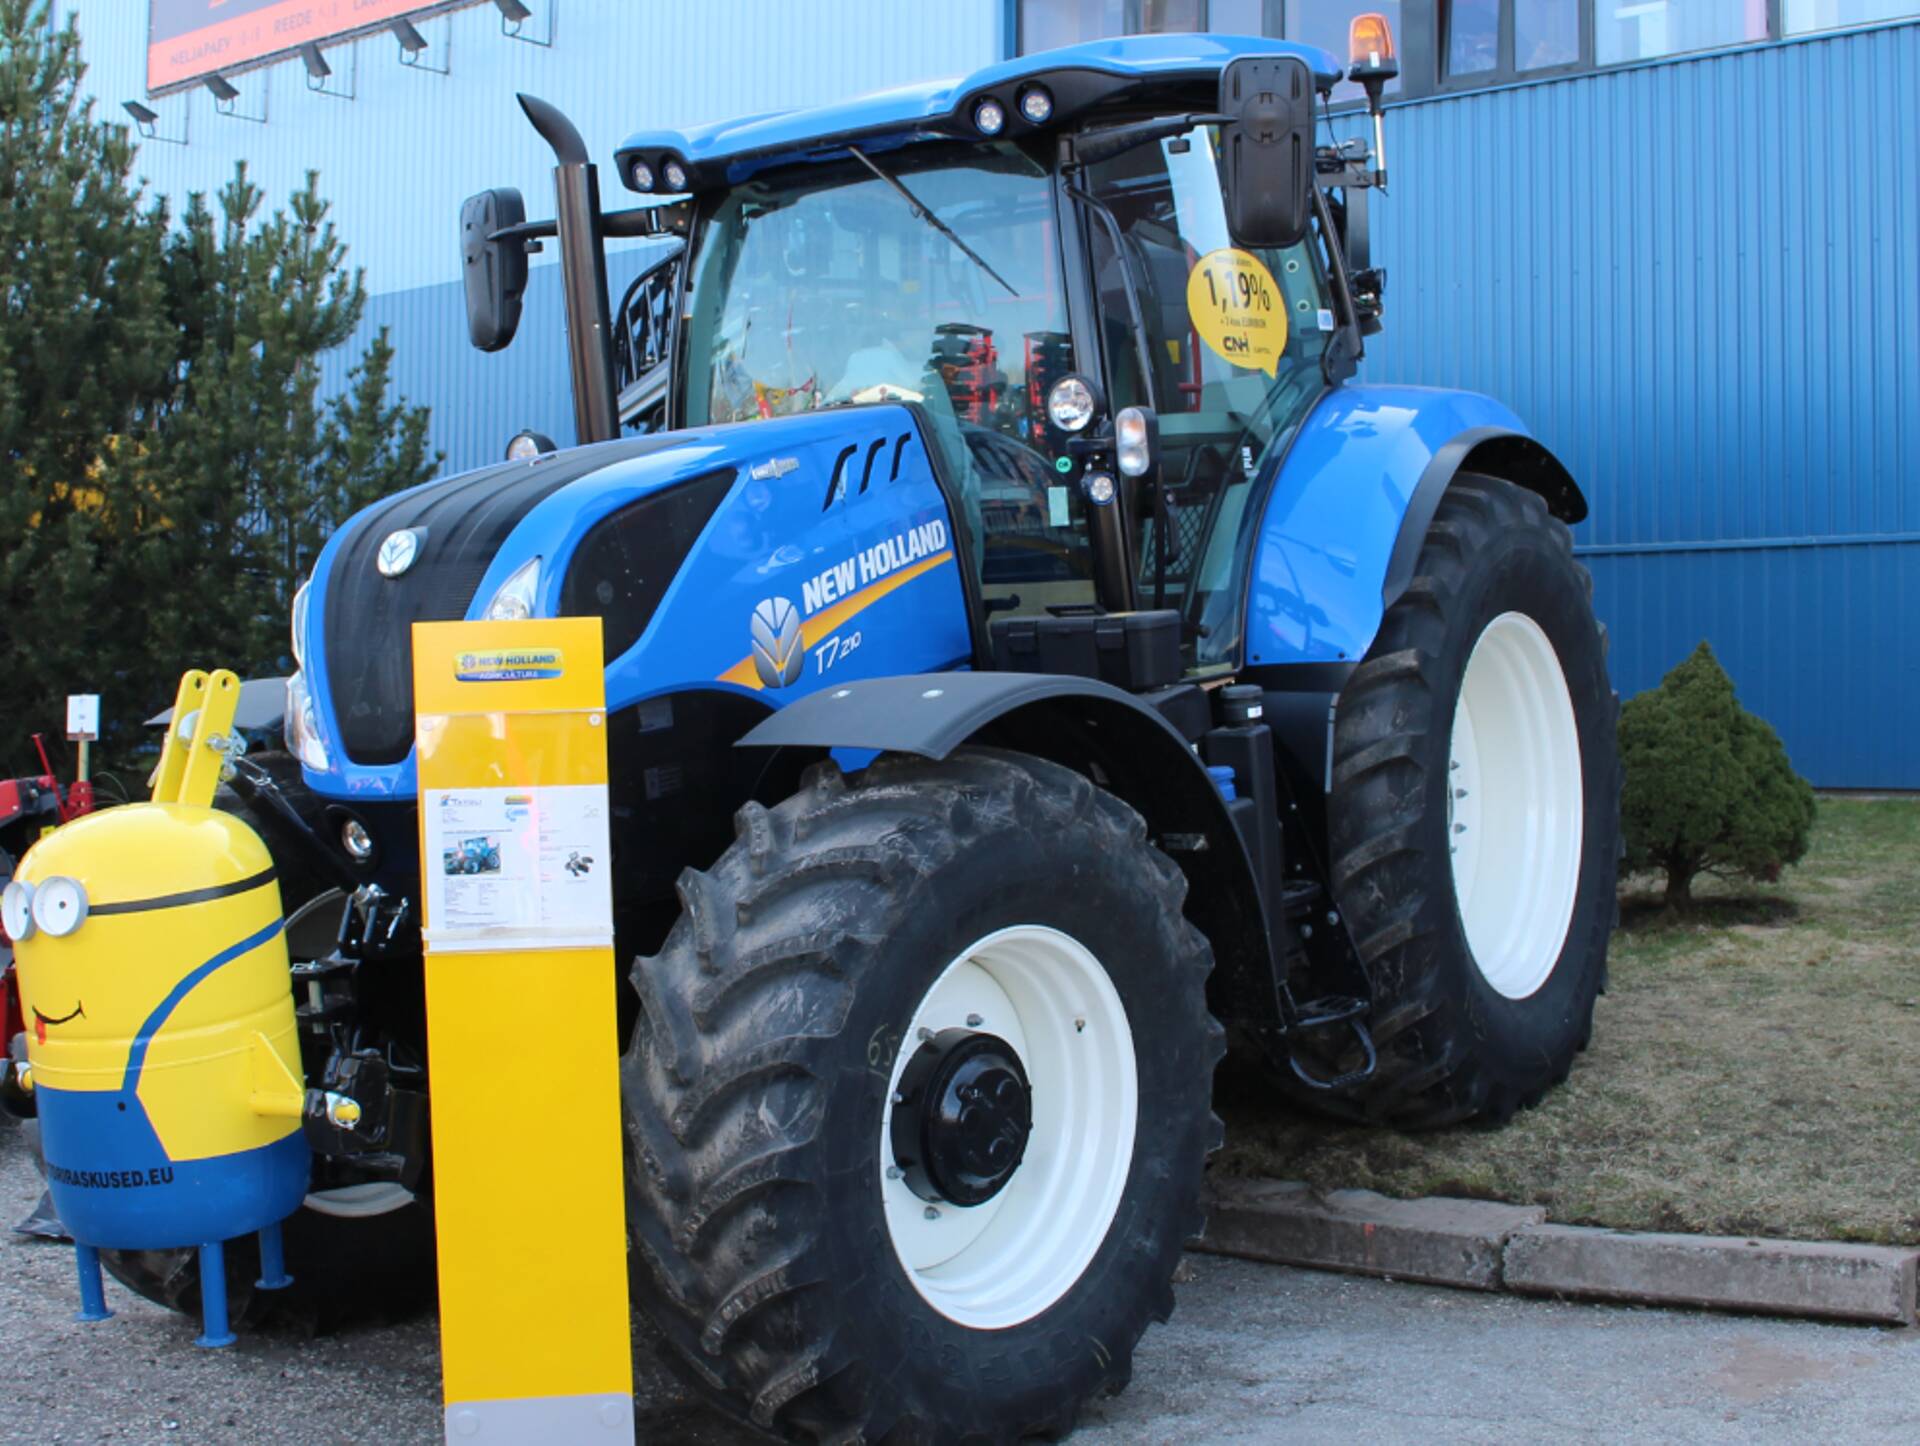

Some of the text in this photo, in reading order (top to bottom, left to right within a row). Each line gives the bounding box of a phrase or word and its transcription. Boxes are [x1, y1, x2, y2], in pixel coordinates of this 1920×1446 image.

[273, 10, 313, 35] REEDE
[1203, 269, 1272, 314] 1,19%
[802, 519, 947, 615] NEW HOLLAND
[506, 655, 556, 665] HOLLAND
